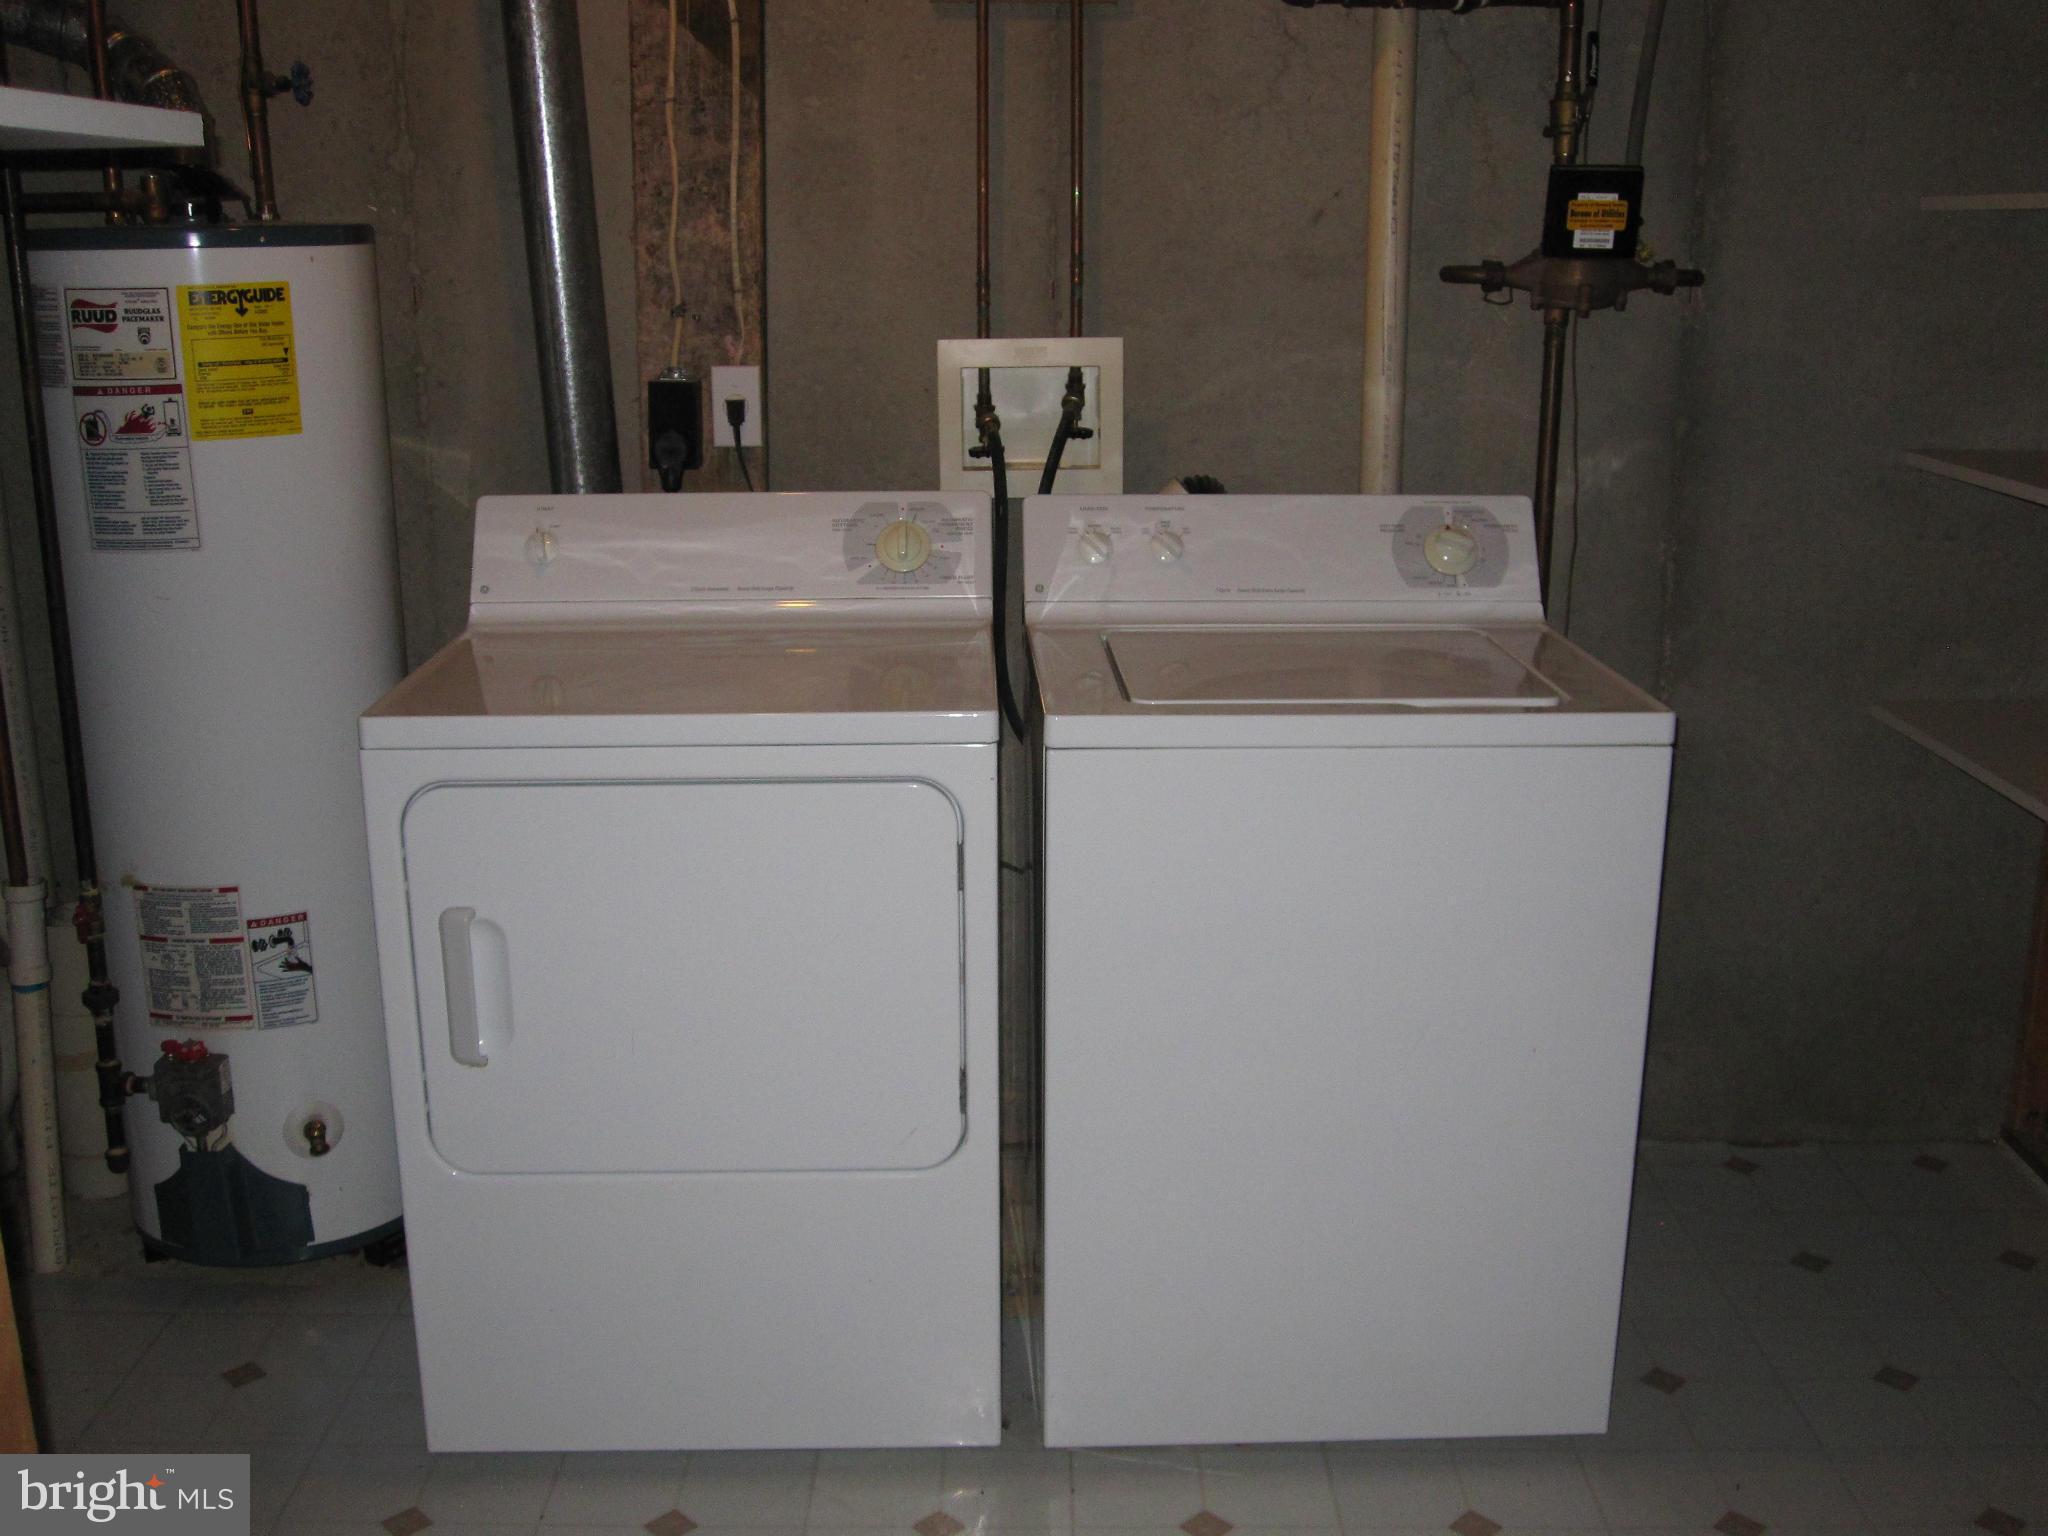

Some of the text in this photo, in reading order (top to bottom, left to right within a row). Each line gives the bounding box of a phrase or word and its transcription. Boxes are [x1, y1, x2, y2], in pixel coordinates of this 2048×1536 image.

[70, 308, 118, 323] RUUD
[107, 386, 152, 394] DANGER
[260, 914, 305, 927] DANGER
